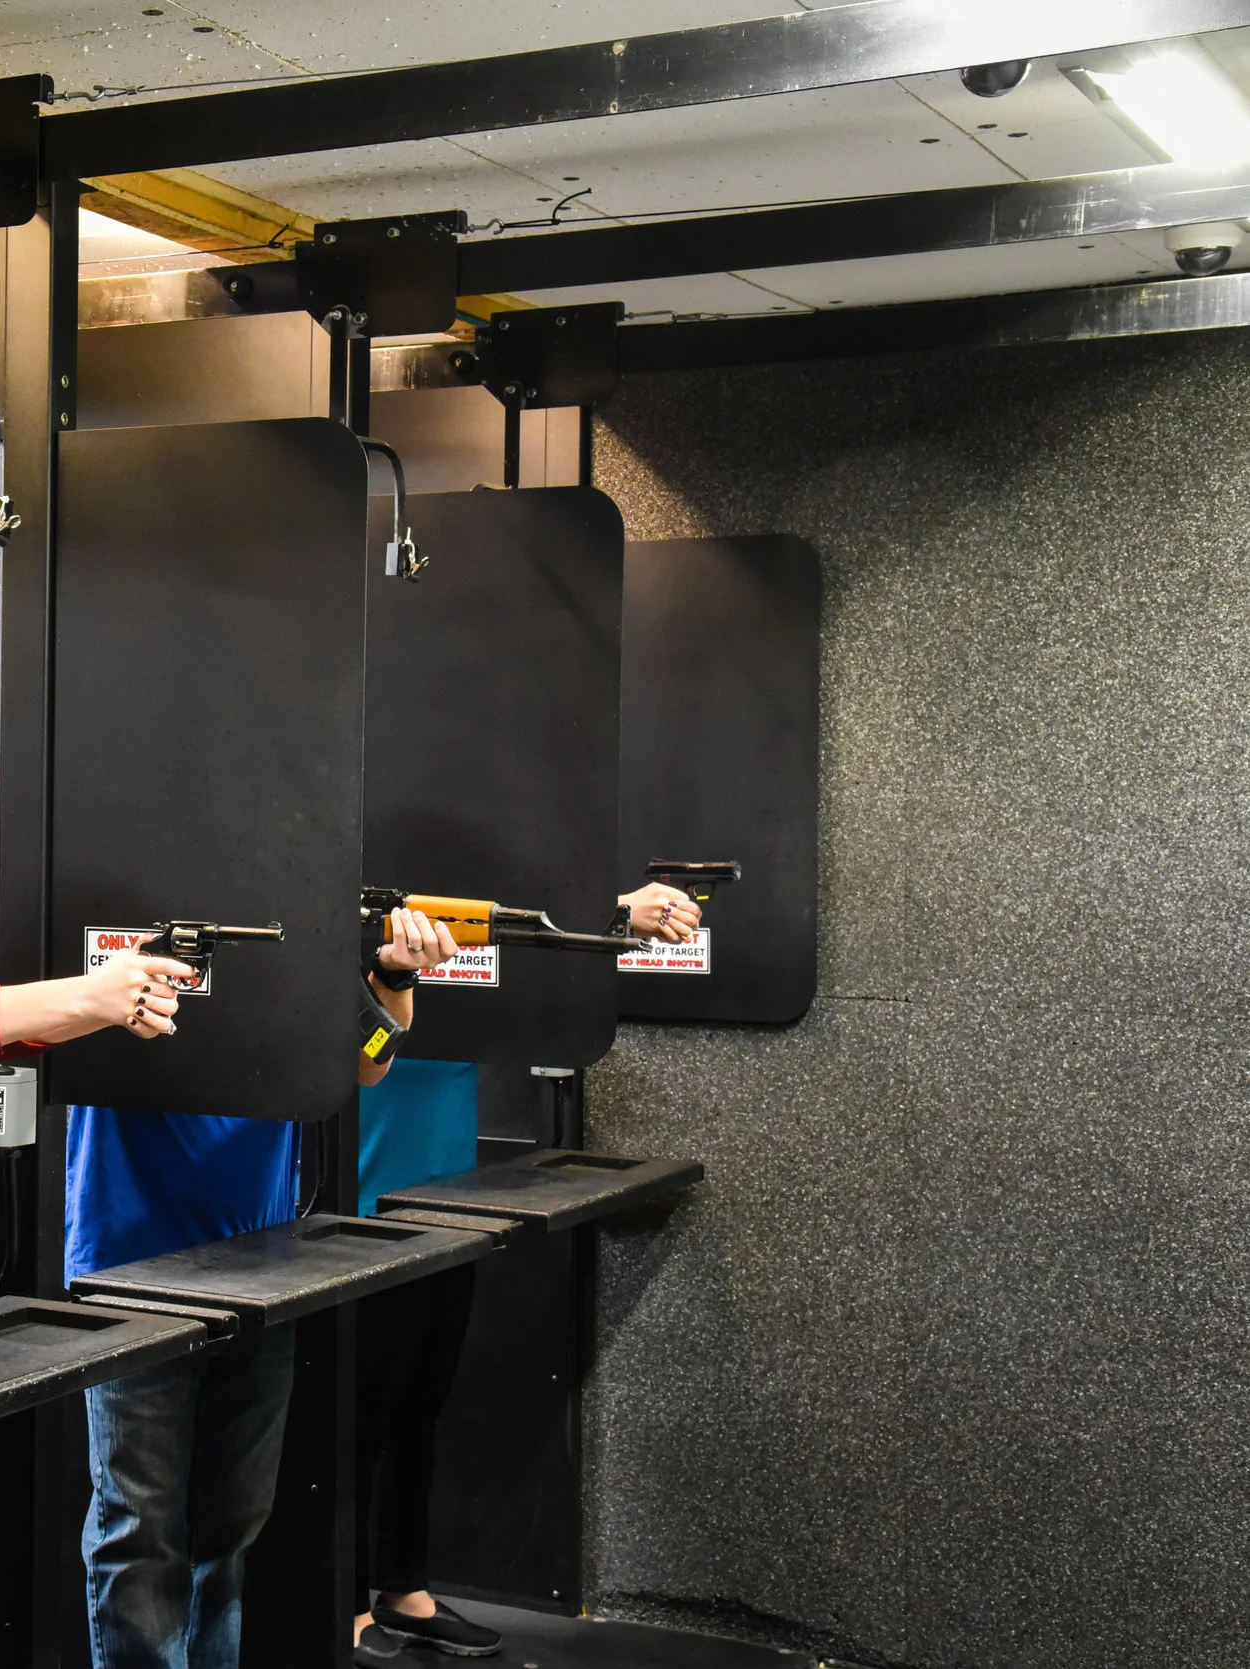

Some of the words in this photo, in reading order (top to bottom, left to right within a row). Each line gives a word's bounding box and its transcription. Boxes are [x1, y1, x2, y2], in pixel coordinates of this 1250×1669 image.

[98, 934, 140, 950] ONLY
[655, 947, 667, 955] OF
[670, 947, 705, 956] TARGET
[454, 955, 493, 966] TARGET
[619, 958, 633, 966] NO
[636, 959, 663, 967] HEAD
[421, 968, 446, 978] EAD
[449, 969, 492, 980] SHOTS!
